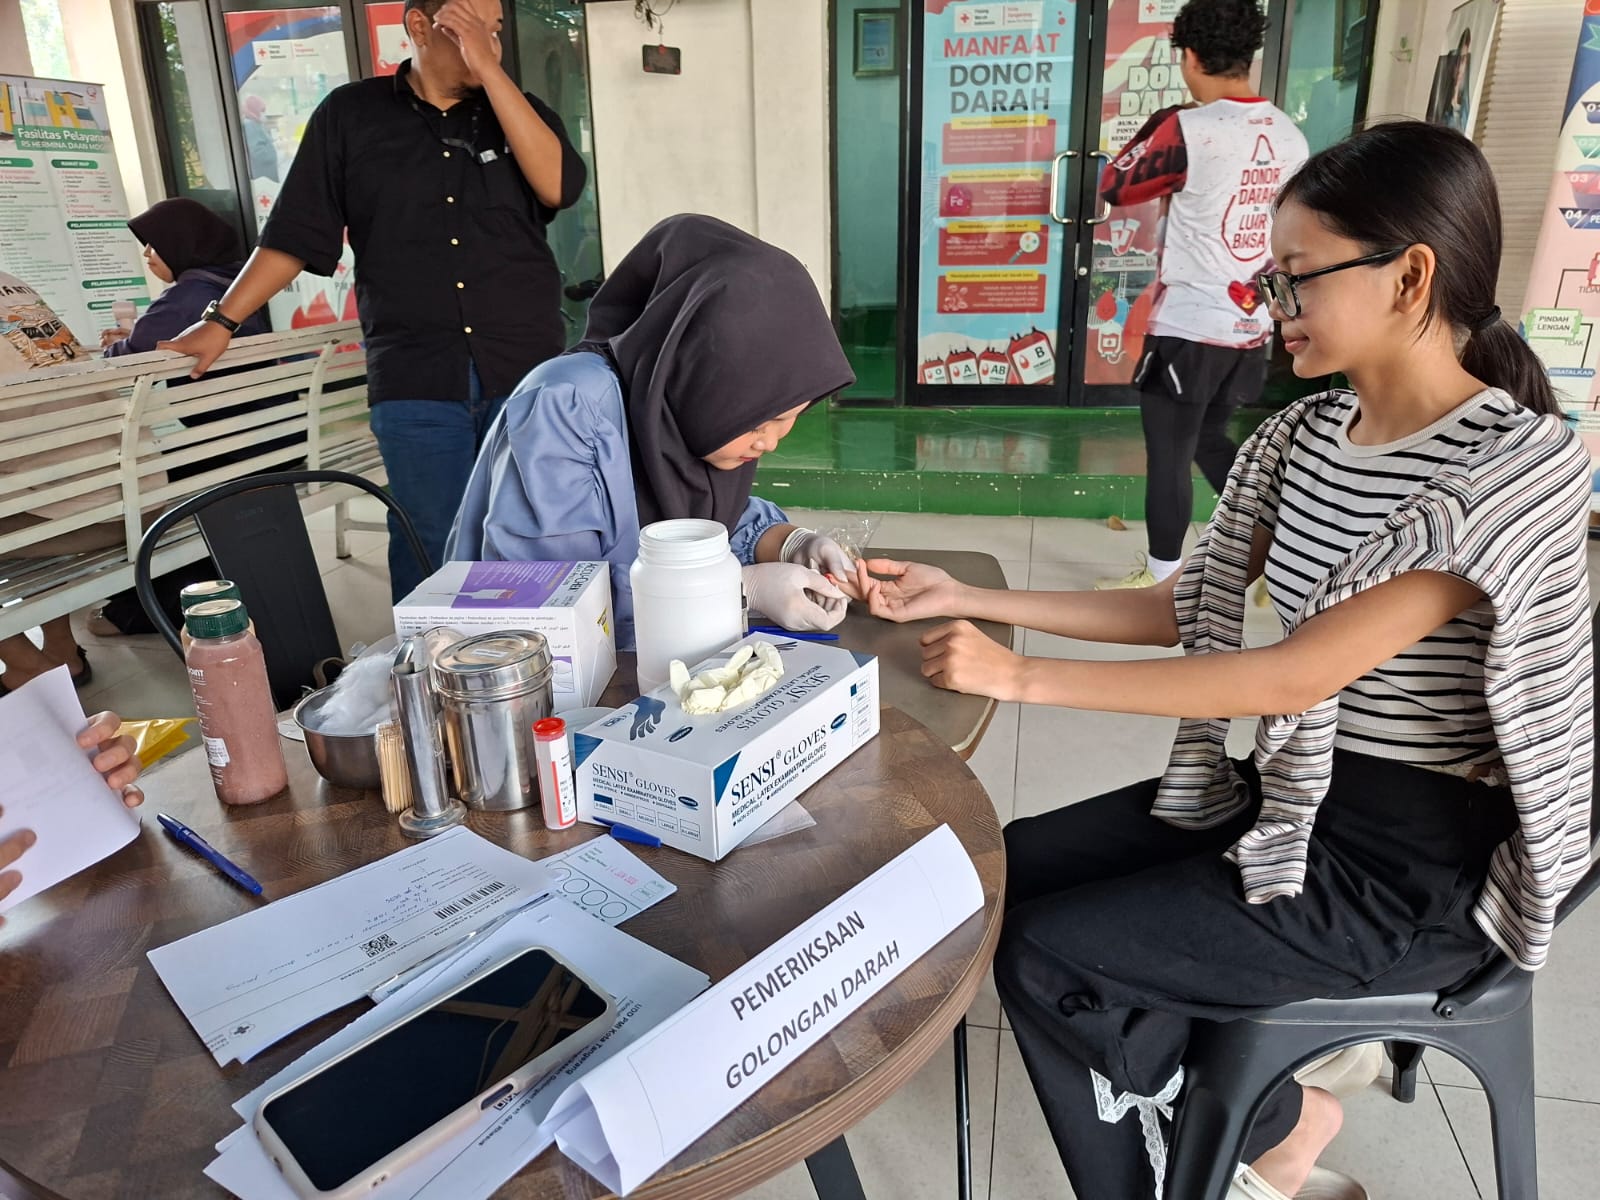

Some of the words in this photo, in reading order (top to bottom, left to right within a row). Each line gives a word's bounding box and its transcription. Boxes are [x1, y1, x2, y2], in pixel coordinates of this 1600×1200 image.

[944, 33, 1060, 58] MANFAAT
[950, 62, 1053, 87] DONOR
[951, 88, 1050, 114] DARAH
[17, 127, 62, 140] Fasilitas
[950, 195, 963, 207] Fe
[1565, 210, 1583, 220] 04
[1537, 324, 1571, 332] LENGAN
[1034, 346, 1045, 358] B
[963, 364, 972, 373] A
[990, 364, 1006, 375] AB
[715, 715, 742, 733] GLOVES
[737, 700, 785, 731] GLOVES
[783, 725, 827, 766] GLOVES
[635, 778, 677, 798] GLOVES
[732, 797, 757, 819] MEDICAL
[757, 785, 774, 800] LATEX
[774, 758, 807, 786] EXAMINATION
[807, 742, 827, 760] GLOVES
[730, 911, 865, 1021] PEMERIKSAAN
[627, 1003, 642, 1017] UDD
[726, 988, 838, 1089] GOLONGAN
[841, 940, 900, 999] DARAH
[615, 1016, 628, 1030] PMI
[600, 1029, 617, 1043] Kota
[565, 1043, 602, 1075] Tangerang
